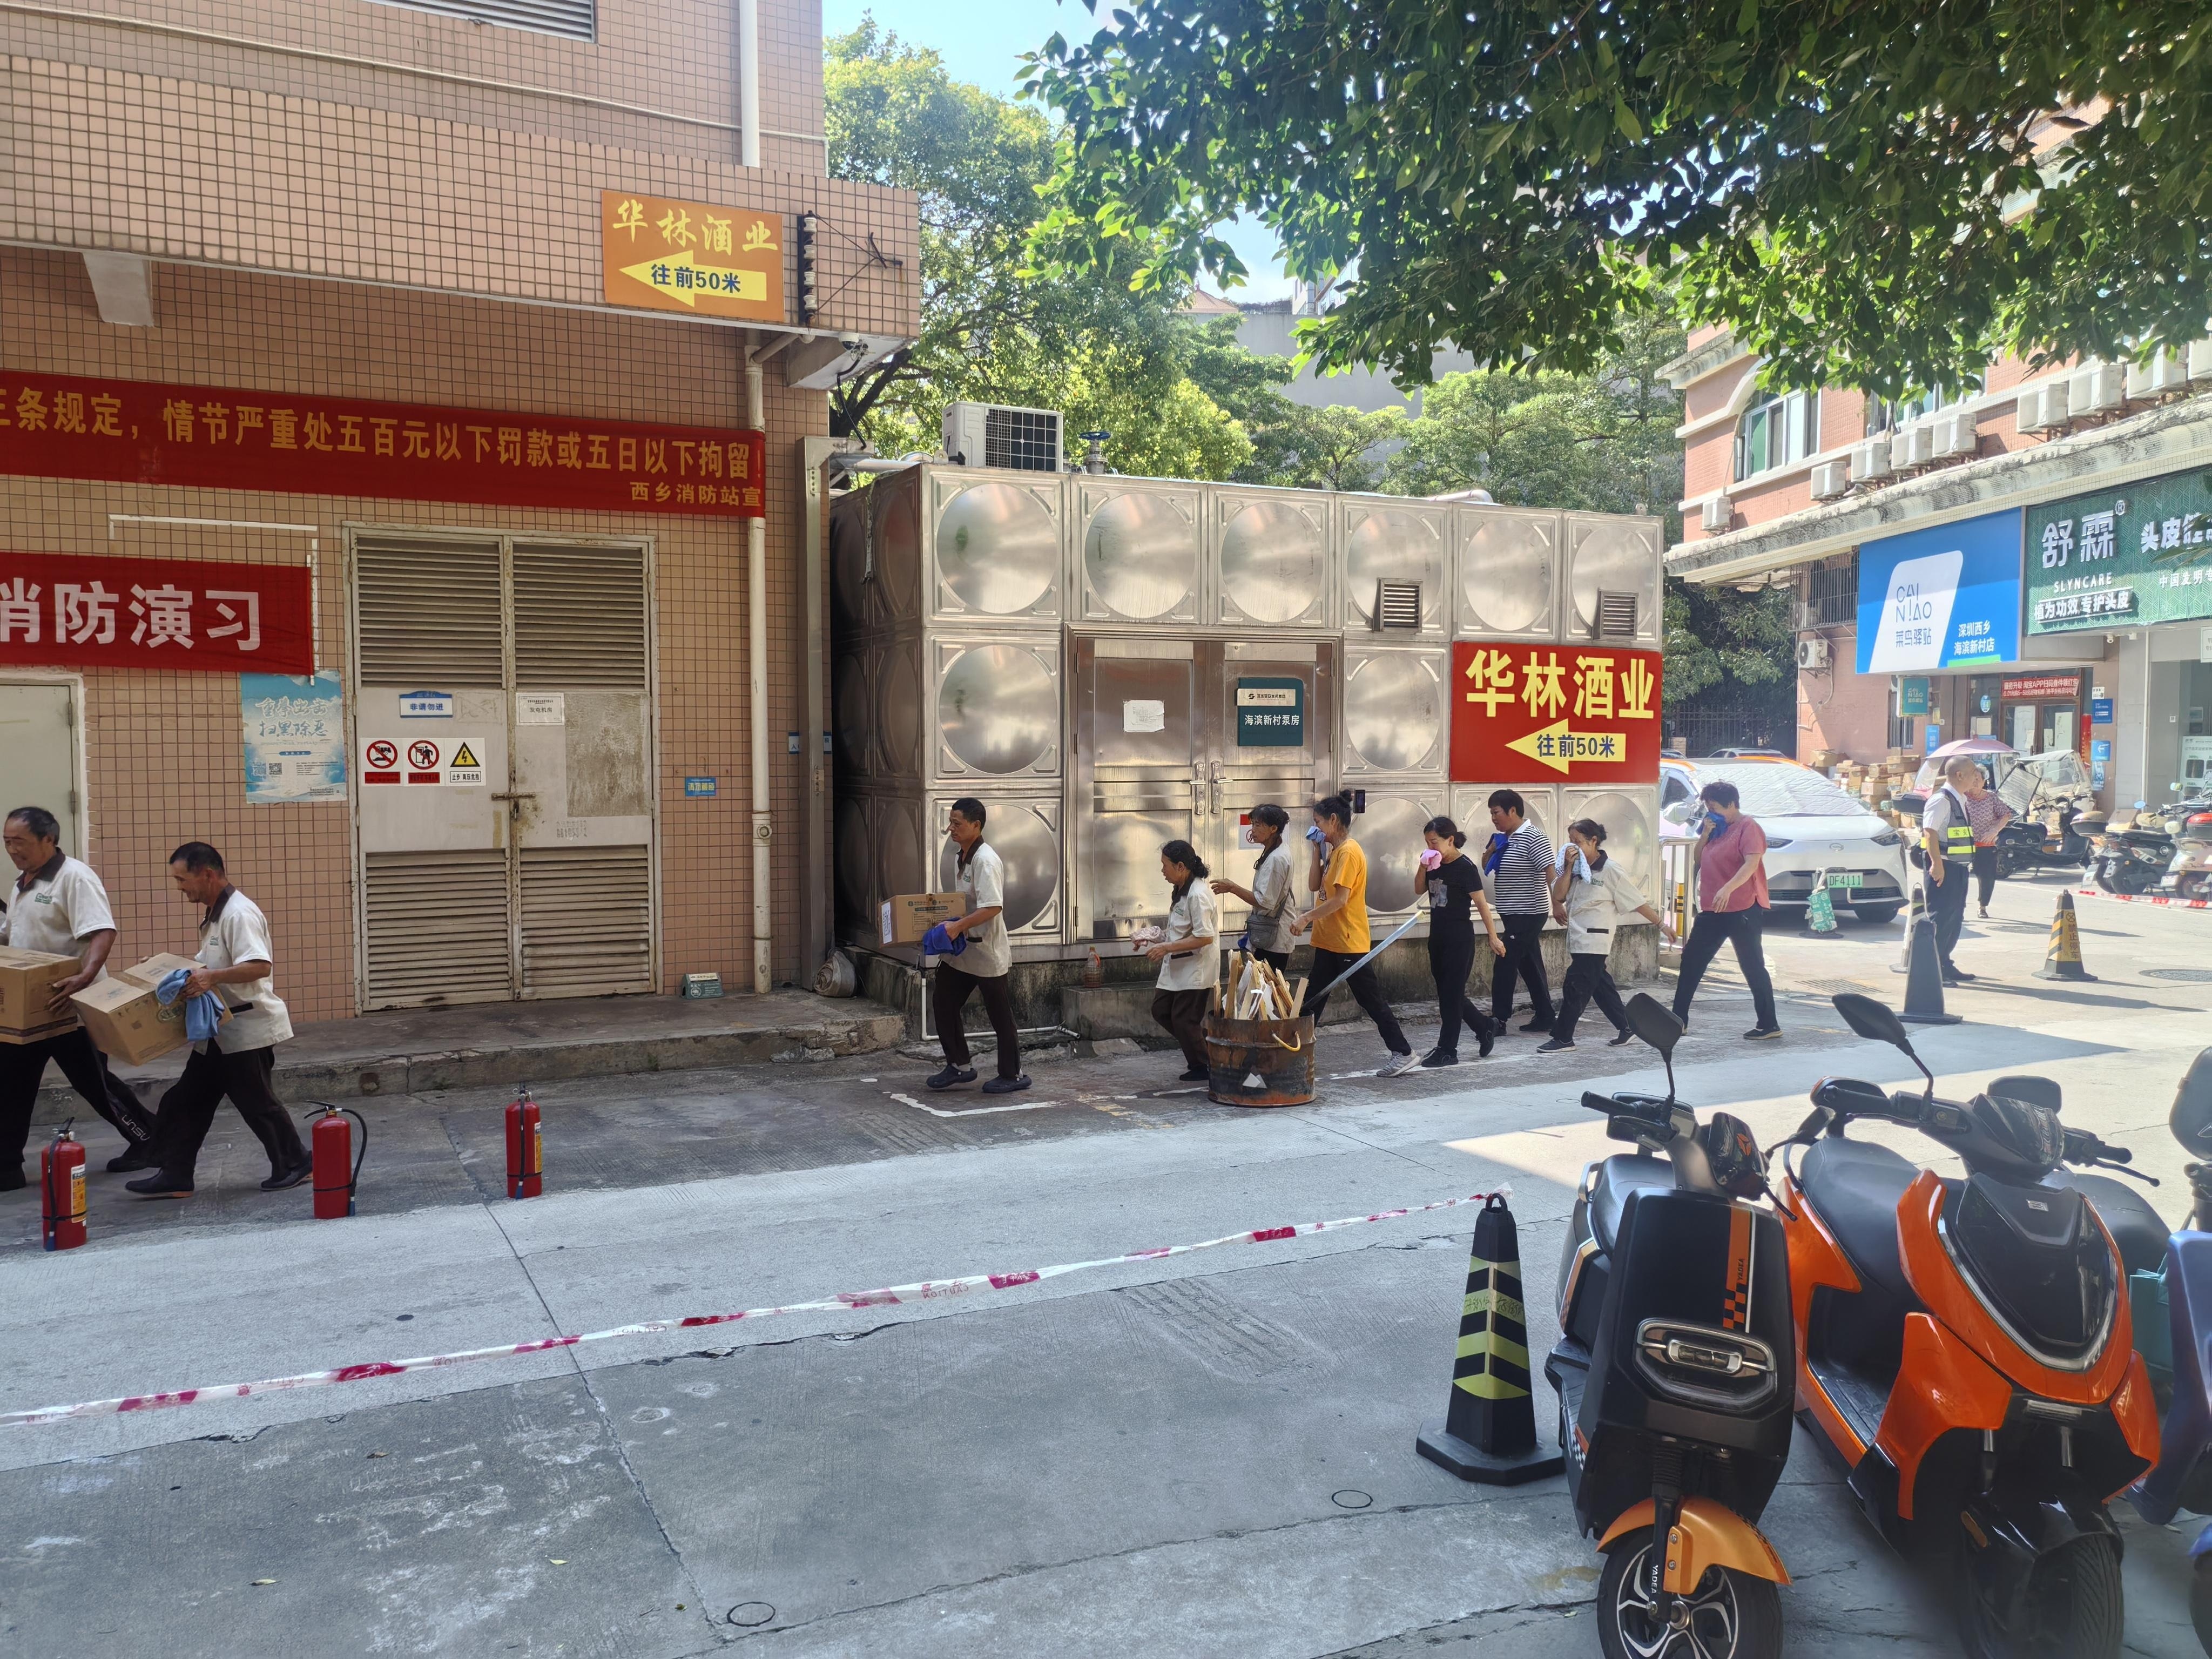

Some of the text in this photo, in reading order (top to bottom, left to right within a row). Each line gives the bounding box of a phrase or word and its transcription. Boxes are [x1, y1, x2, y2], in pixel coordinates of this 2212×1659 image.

[613, 199, 778, 256] 华林酒业
[651, 264, 741, 293] 往前50米
[630, 482, 761, 506] 西乡消防站宣
[2054, 572, 2112, 593] SLYNCARE
[1897, 583, 1919, 603] CAI
[1896, 628, 1932, 648] 菜鸟驿站
[1958, 620, 1991, 638] 深圳西乡
[1954, 638, 1995, 656] 海滨新村店
[1466, 649, 1654, 719] 华林酒业
[259, 719, 328, 737] 扫黑除恶
[1244, 714, 1300, 726] 海滨新村泵房
[1536, 734, 1615, 758] 往前50米
